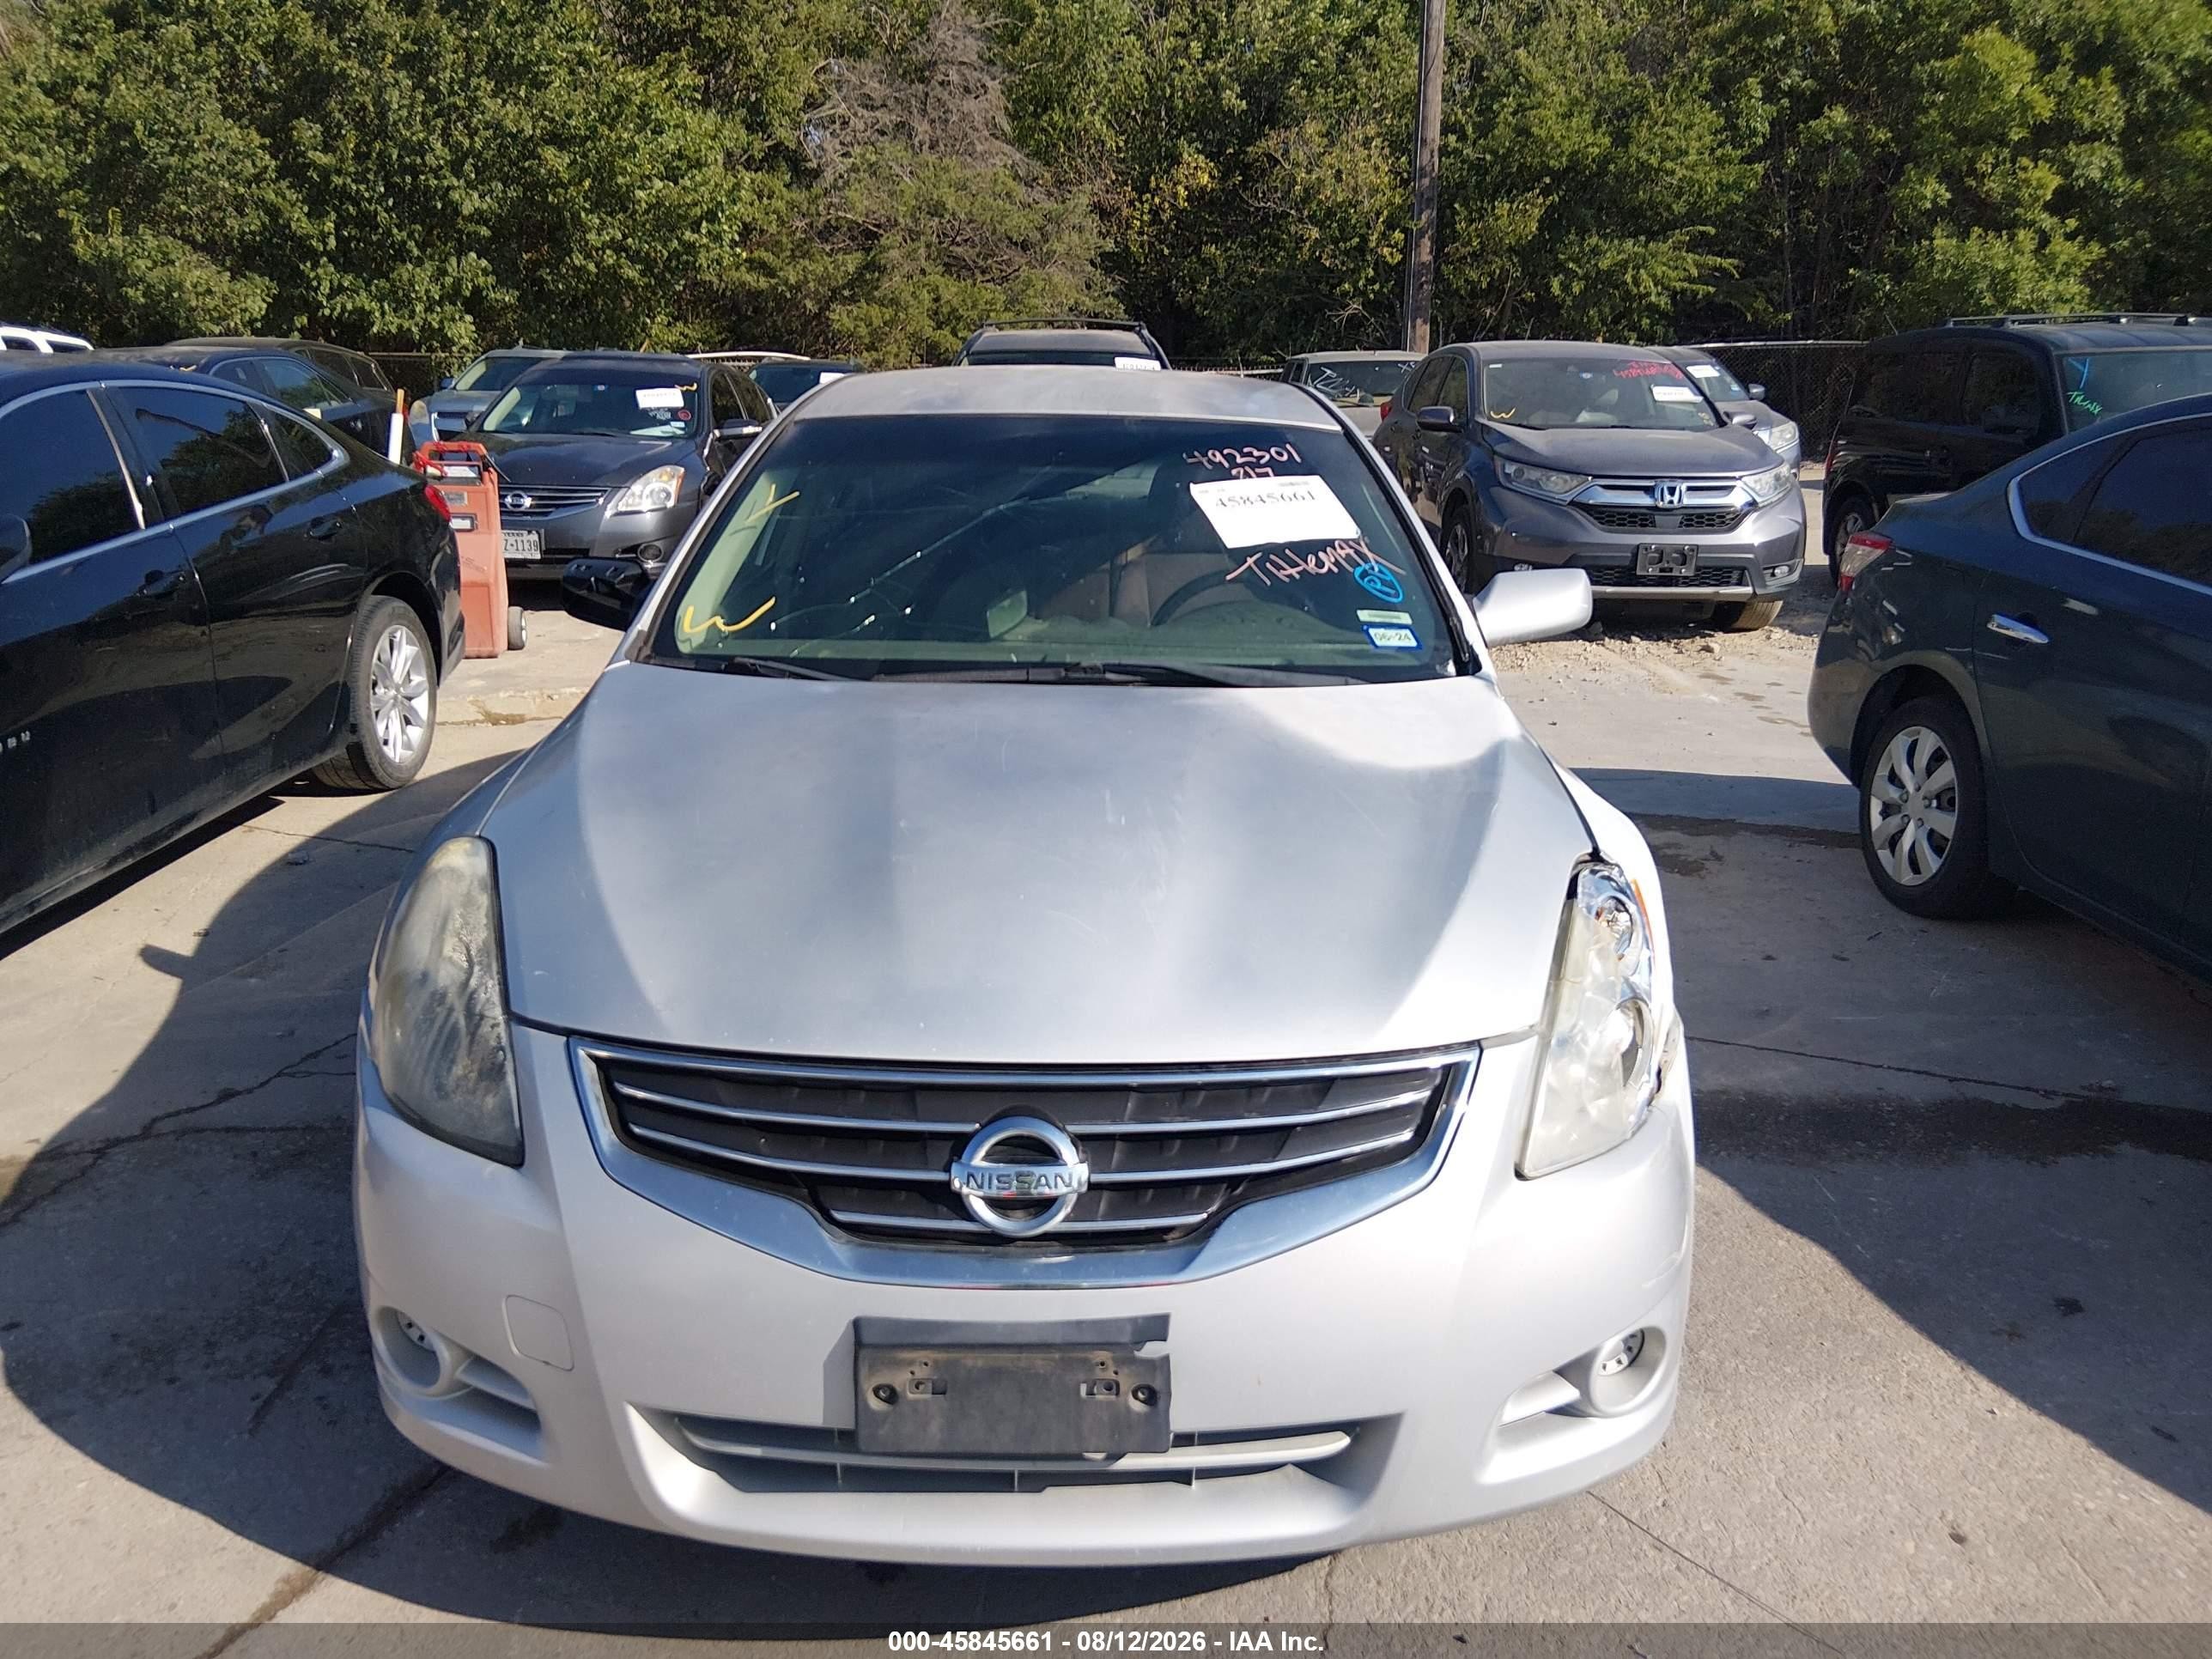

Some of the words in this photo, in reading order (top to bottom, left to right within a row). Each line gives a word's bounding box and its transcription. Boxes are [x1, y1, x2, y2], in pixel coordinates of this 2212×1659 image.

[1182, 443, 1302, 470] 492301
[1215, 489, 1316, 508] 45845661
[965, 1170, 1073, 1190] NISSAN
